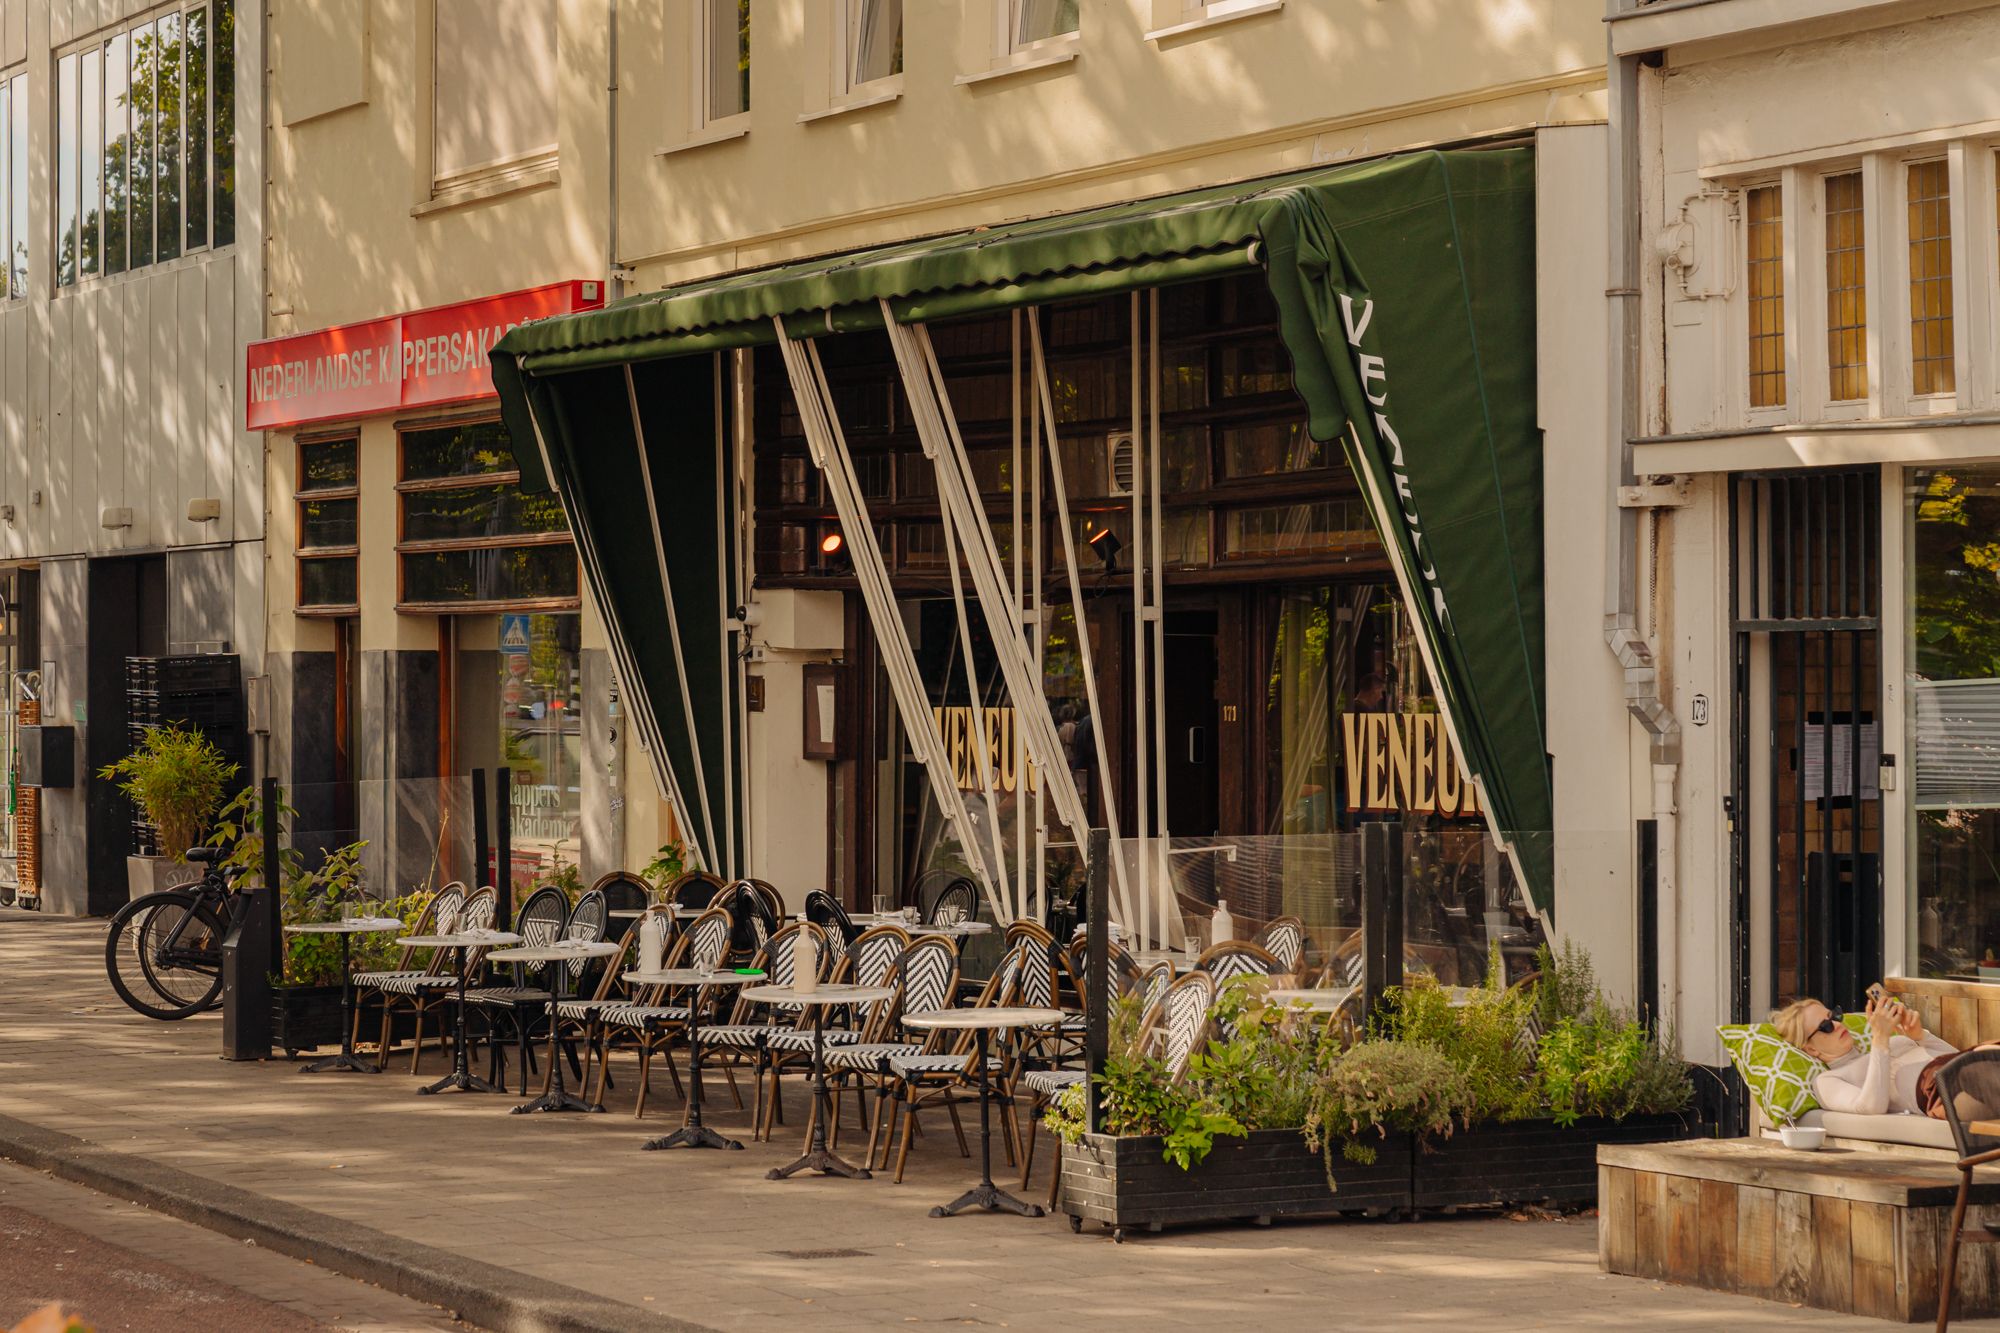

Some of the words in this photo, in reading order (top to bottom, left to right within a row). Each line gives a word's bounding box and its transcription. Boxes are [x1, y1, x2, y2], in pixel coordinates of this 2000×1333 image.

[251, 348, 372, 403] NEDERLANDSE
[379, 316, 530, 385] KAPPERSAKA
[1223, 705, 1237, 721] 171
[1692, 699, 1706, 721] 173
[1342, 712, 1486, 814] VENEU
[510, 775, 561, 816] appers
